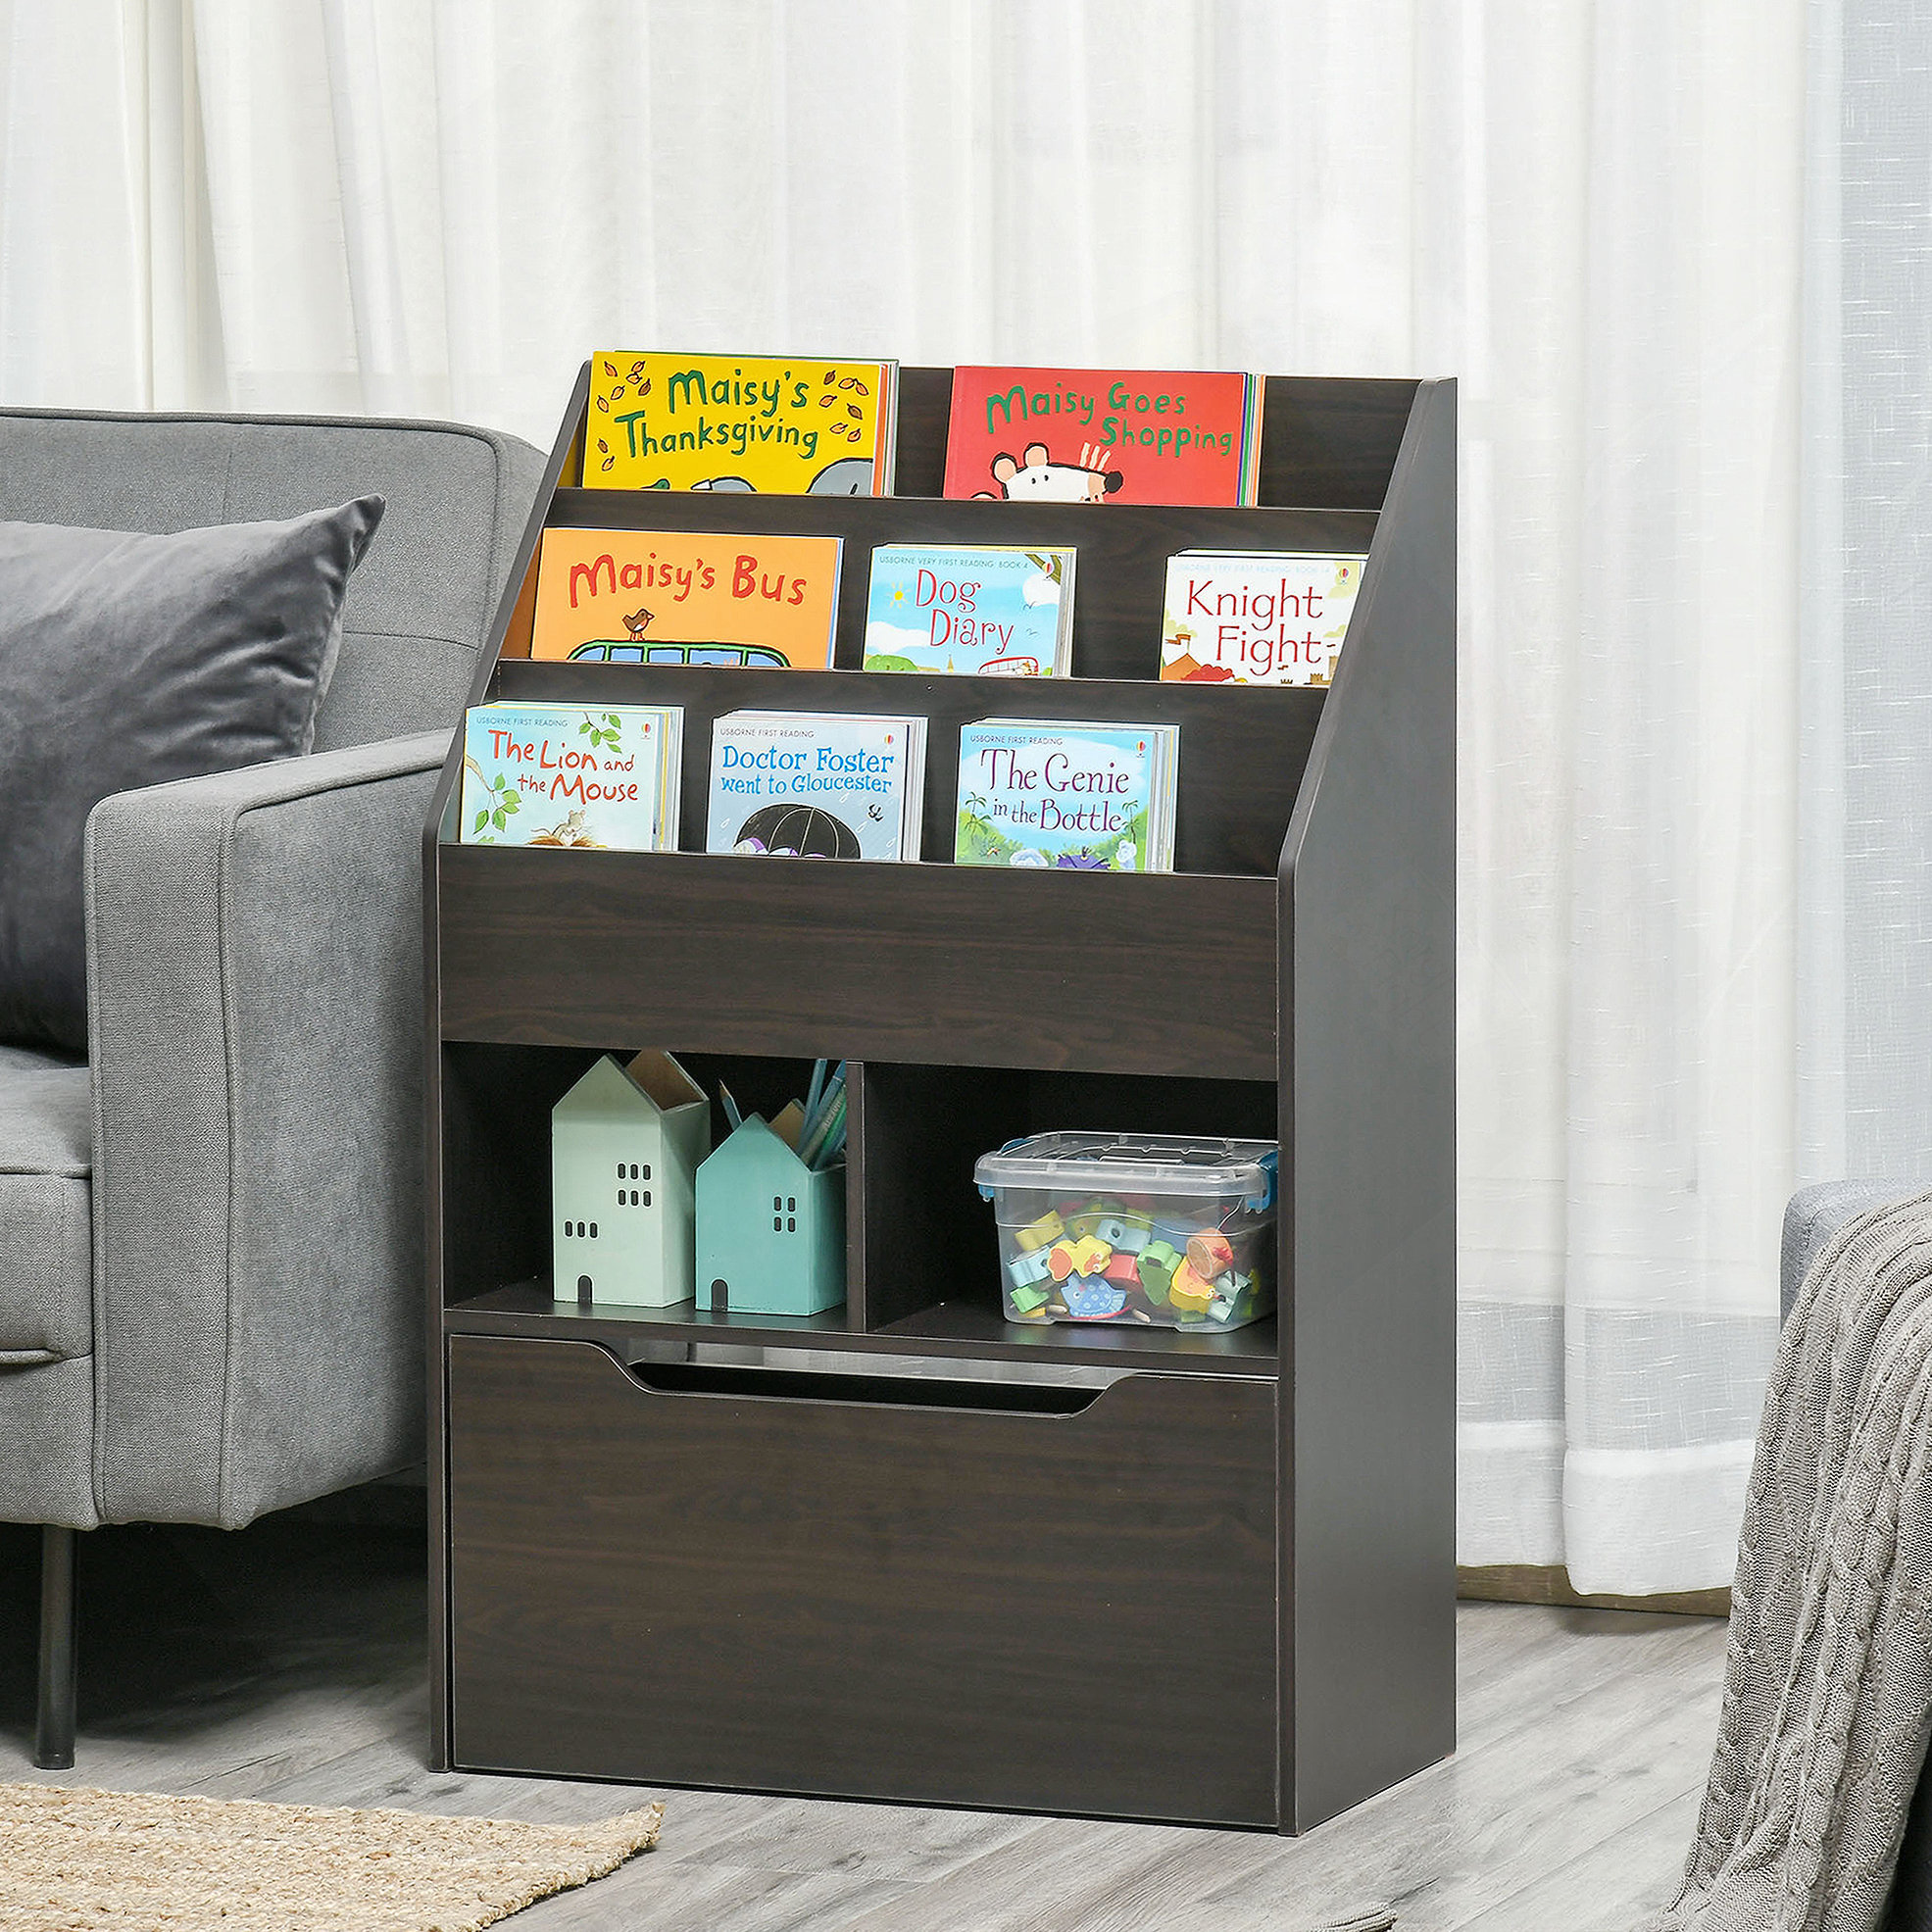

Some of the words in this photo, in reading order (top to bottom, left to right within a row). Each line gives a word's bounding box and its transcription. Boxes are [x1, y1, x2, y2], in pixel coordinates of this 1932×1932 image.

[668, 369, 810, 418] Maisy's
[986, 382, 1095, 434] Maisy
[1108, 381, 1186, 414] Goes
[615, 410, 818, 460] Thanksgiving
[1099, 417, 1233, 457] Shopping
[570, 552, 716, 609] Maisy's
[732, 555, 807, 606] Bus
[879, 556, 915, 566] USBORNE
[917, 557, 937, 566] VERY
[960, 559, 994, 568] READING
[999, 560, 1021, 569] BOOK
[916, 569, 981, 613] Dog
[1187, 578, 1323, 631] Knight
[930, 609, 1015, 655] Diary
[1215, 623, 1321, 676] Fight
[476, 717, 511, 725] USBORNE
[514, 718, 531, 726] FIRST
[534, 718, 569, 727] READING
[719, 727, 756, 736] USBORNE
[758, 728, 777, 737] FIRST
[779, 729, 815, 738] READING
[970, 734, 1006, 743] USBORNE
[1008, 735, 1026, 744] FIRST
[1028, 736, 1064, 745] READING
[488, 729, 534, 763] The
[540, 740, 598, 771] Lion
[604, 754, 635, 771] and
[722, 745, 807, 770] Doctor
[817, 747, 894, 773] Foster
[518, 773, 546, 792] the
[550, 773, 638, 805] Mouse
[720, 774, 762, 794] went
[768, 774, 787, 794] to
[791, 772, 892, 794] Gloucester
[980, 749, 1037, 790] The
[1044, 753, 1129, 794] Genie
[993, 798, 1008, 817] in
[1012, 801, 1037, 823] the
[1040, 798, 1122, 832] Bottle
